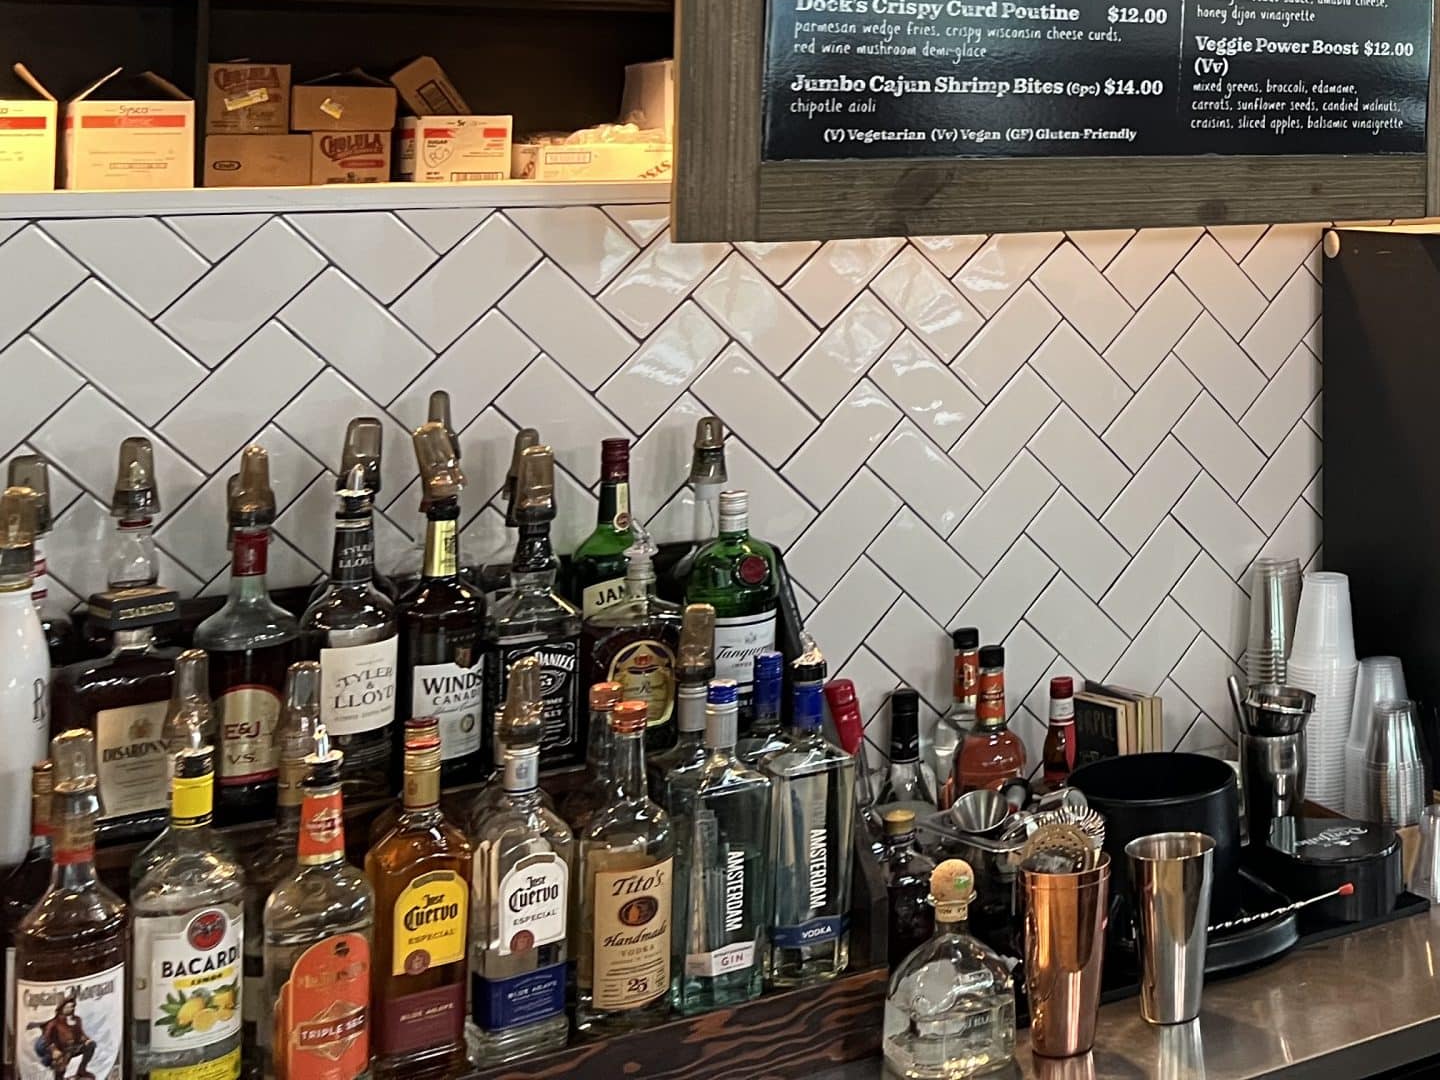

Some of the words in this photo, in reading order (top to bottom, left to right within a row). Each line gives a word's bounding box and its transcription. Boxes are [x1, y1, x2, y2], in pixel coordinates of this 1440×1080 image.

[946, 0, 998, 18] Curd
[1001, 2, 1080, 21] Poutine
[1107, 5, 1167, 24] $12.00
[1195, 36, 1253, 56] Veggie
[1255, 38, 1310, 54] Power
[1312, 40, 1359, 55] Boost
[1364, 40, 1414, 57] $12.00
[1194, 57, 1228, 76] (Vv)
[790, 74, 866, 92] Jumbo
[869, 75, 931, 97] Cajun
[934, 76, 1010, 98] Shrimp
[1012, 77, 1064, 94] Bites
[1066, 81, 1101, 97] (6pc)
[1104, 78, 1163, 96] $14.00
[790, 97, 843, 119] chipotle
[848, 98, 876, 113] aioli
[824, 128, 845, 143] (V)
[847, 128, 926, 143] Vegetarian
[930, 128, 958, 142] (Vv)
[960, 129, 1001, 143] Vegan
[1005, 128, 1034, 142] (GF)
[1035, 128, 1137, 142] Gluten-Friendly
[320, 133, 384, 162] CHOLULA
[335, 666, 392, 689] TYLER
[366, 682, 374, 690] &
[334, 684, 393, 709] LLOYD
[223, 721, 261, 741] E&J
[809, 828, 827, 910] AMSTERDAM
[612, 869, 665, 897] Tito's
[725, 850, 745, 932] AMSTERDAM
[508, 883, 559, 913] Cuervo
[403, 902, 458, 932] Cuervo
[513, 910, 557, 926] ESPECIAL
[408, 928, 456, 946] ESPECIAL
[602, 921, 668, 948] Handmade
[802, 925, 833, 939] VODKA
[720, 952, 744, 967] GIN
[627, 976, 648, 993] 25
[301, 1024, 344, 1041] TRIPLE
[345, 1014, 365, 1031] SEC
